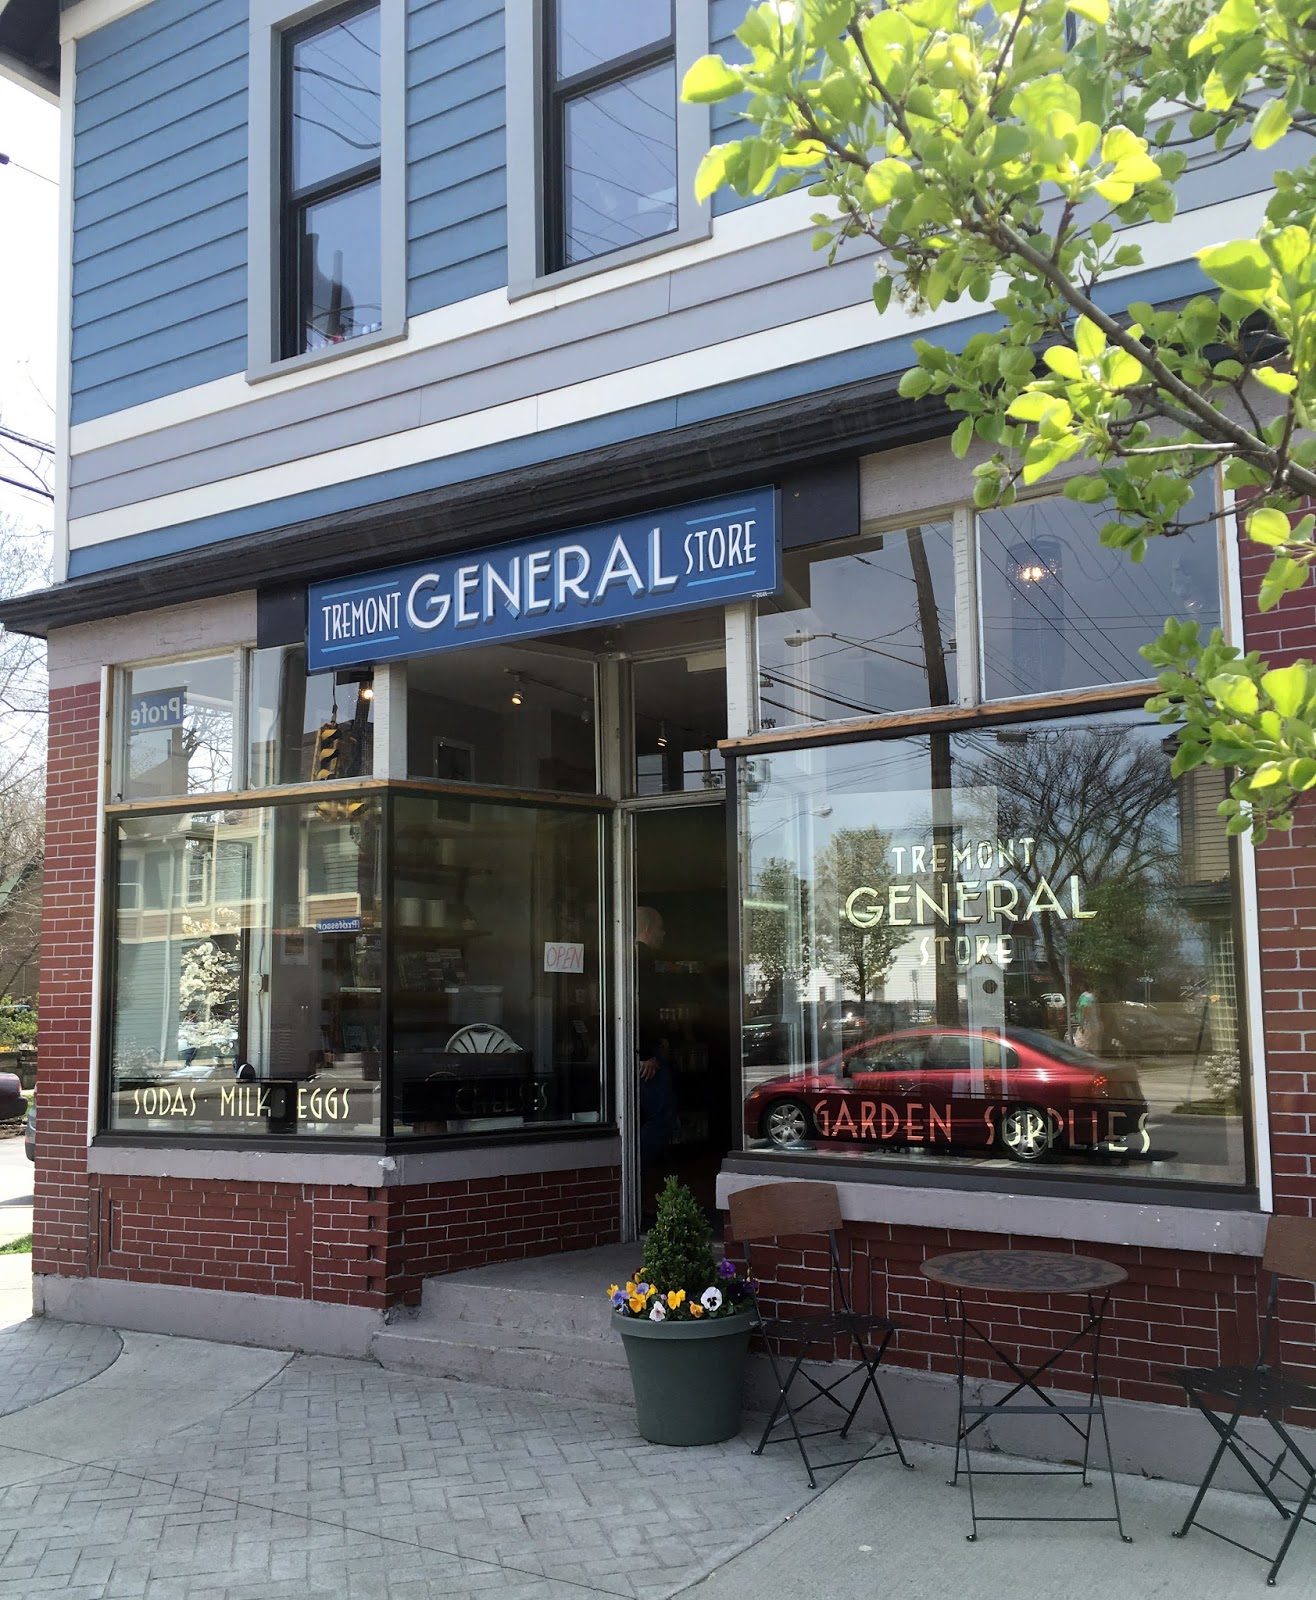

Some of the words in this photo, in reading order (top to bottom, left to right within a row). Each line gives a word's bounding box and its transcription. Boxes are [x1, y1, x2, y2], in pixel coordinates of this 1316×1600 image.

[322, 591, 401, 642] TREMONT
[406, 527, 678, 635] GENERAL
[683, 519, 757, 576] STORE
[891, 837, 1036, 875] TREMONT
[844, 875, 1099, 929] GENERAL
[546, 946, 584, 969] OPEN
[919, 934, 1014, 966] STORE
[134, 1086, 197, 1116] SODAS
[220, 1085, 272, 1117] MILK
[297, 1086, 350, 1120] EGGS
[813, 1099, 952, 1143] GARDEN
[984, 1104, 1151, 1154] SUPPLIES
